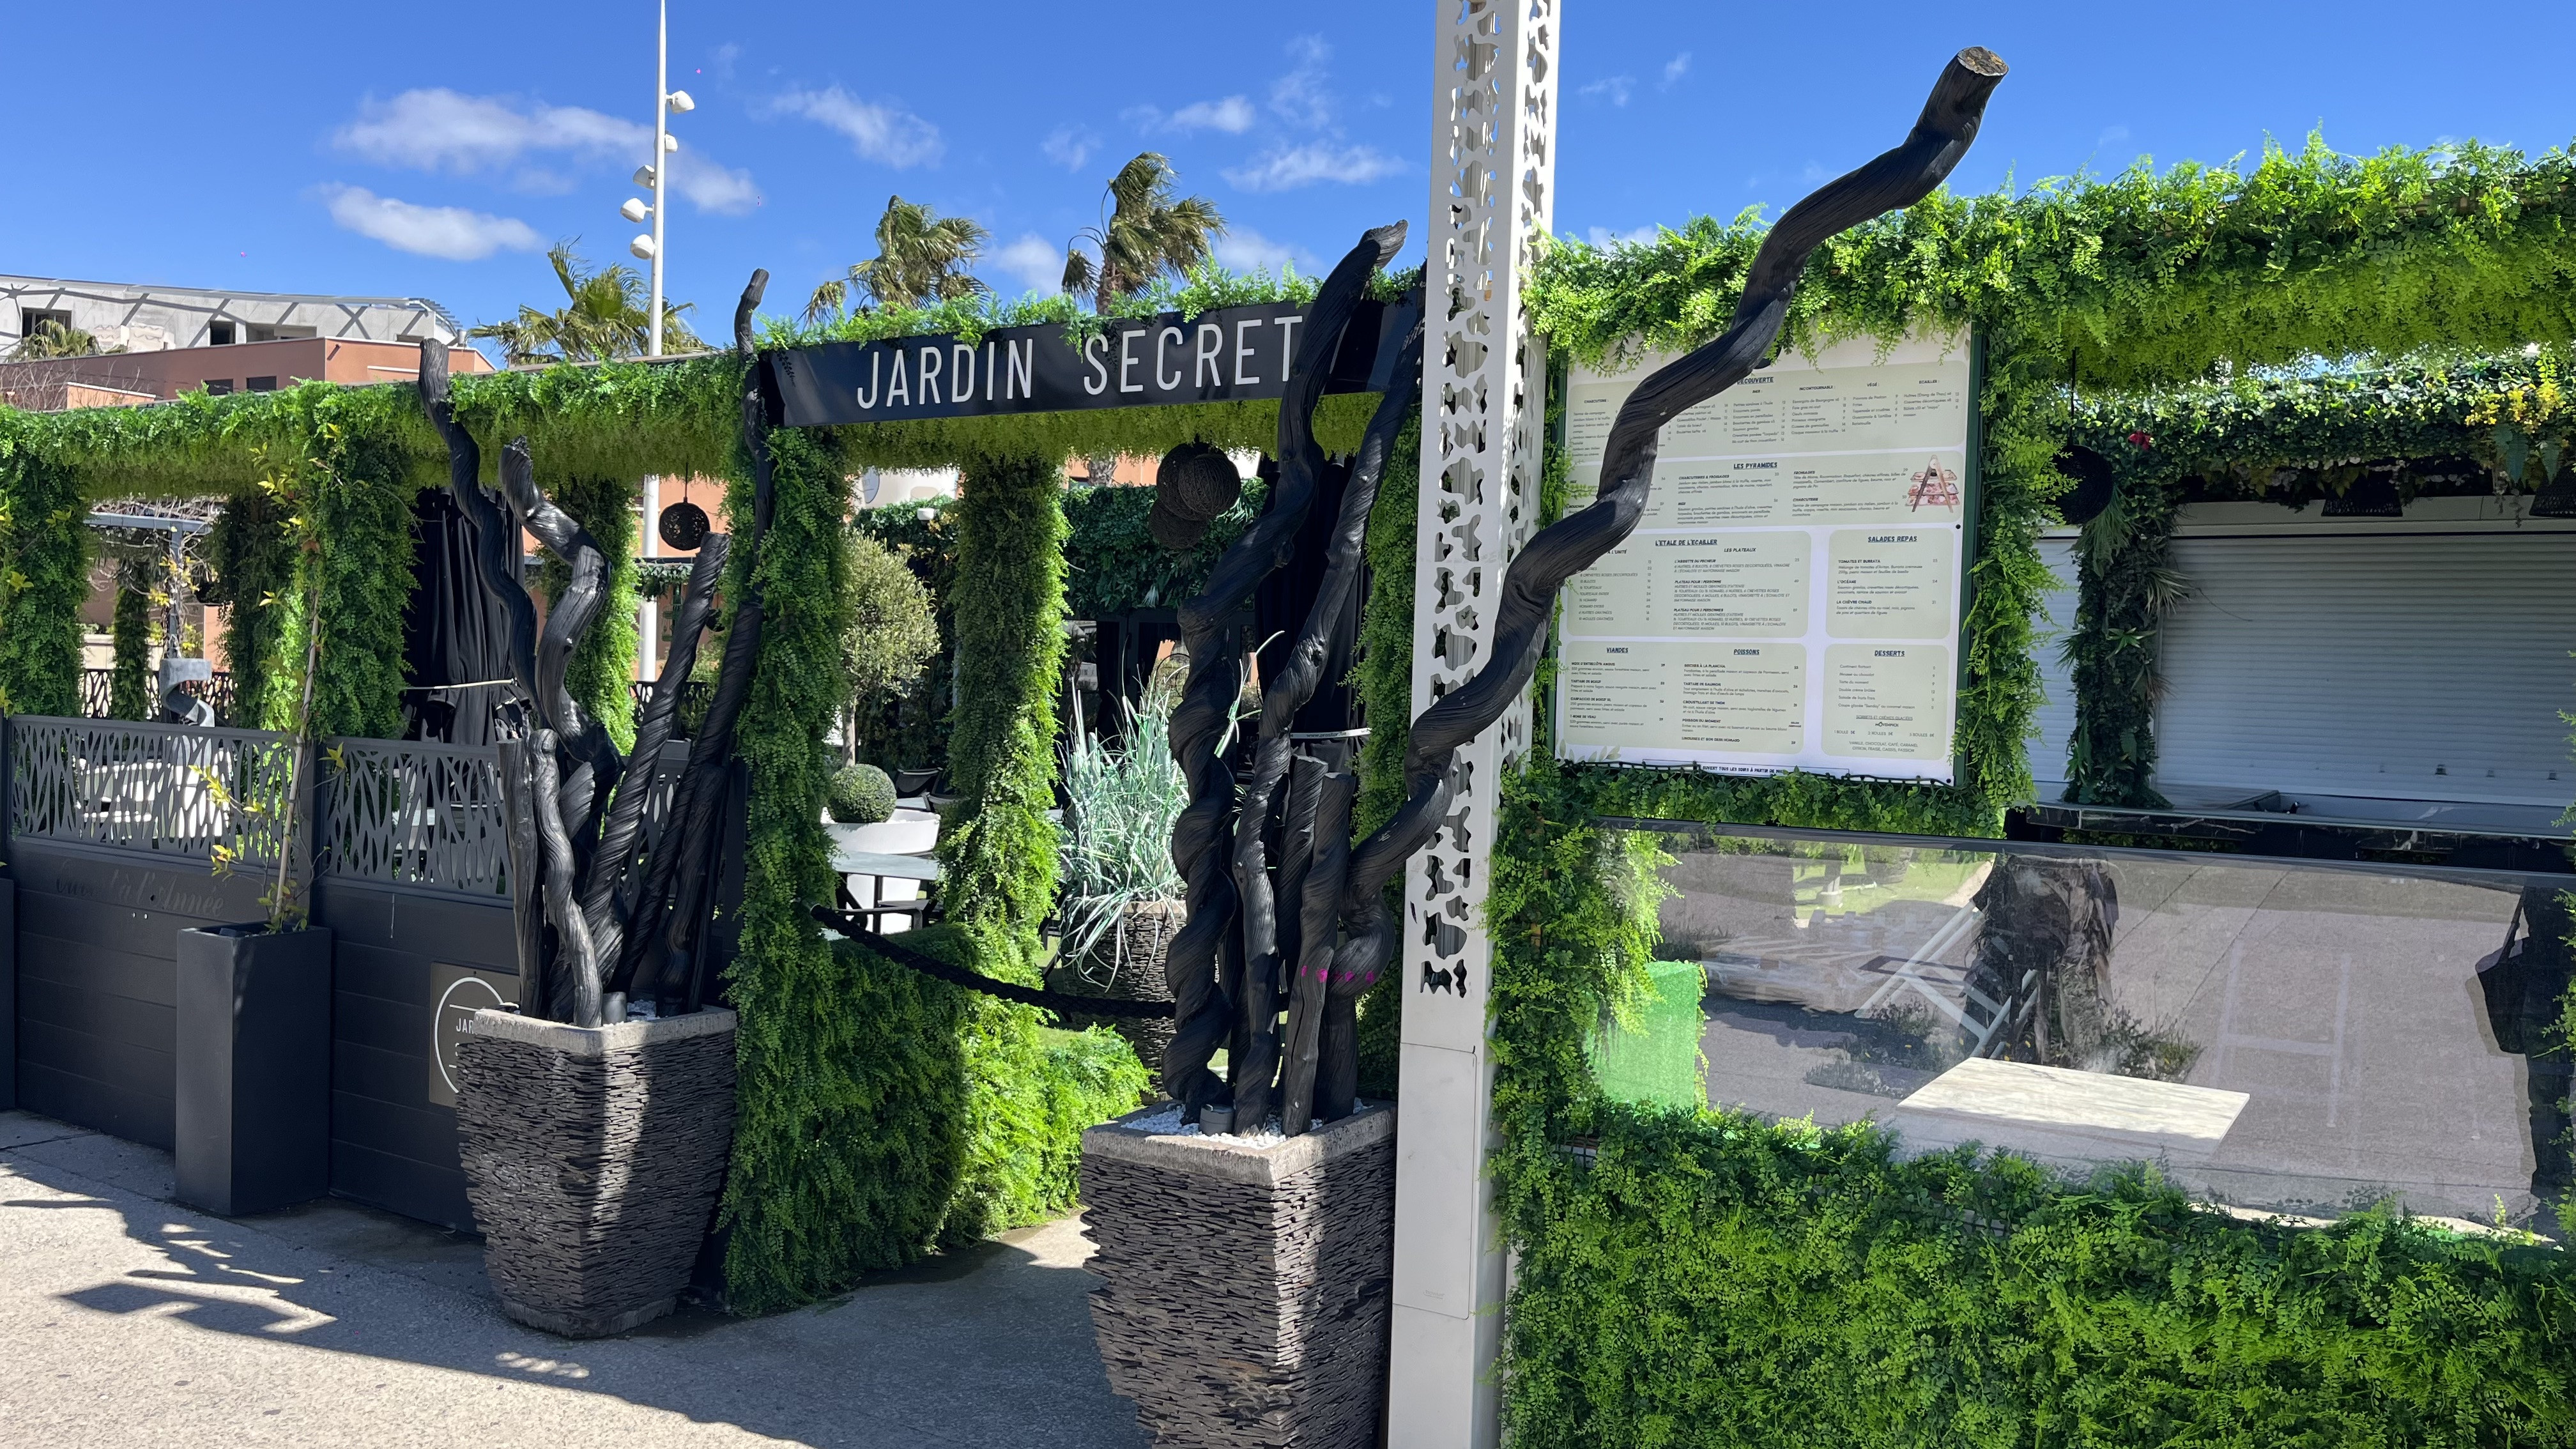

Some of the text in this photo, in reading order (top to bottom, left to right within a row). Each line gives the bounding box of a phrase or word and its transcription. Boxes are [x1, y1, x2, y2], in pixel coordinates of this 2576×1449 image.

[857, 315, 1303, 410] JARDIN SECRET
[1745, 461, 1777, 470] PYRAMIDES
[456, 1018, 475, 1035] JAR
